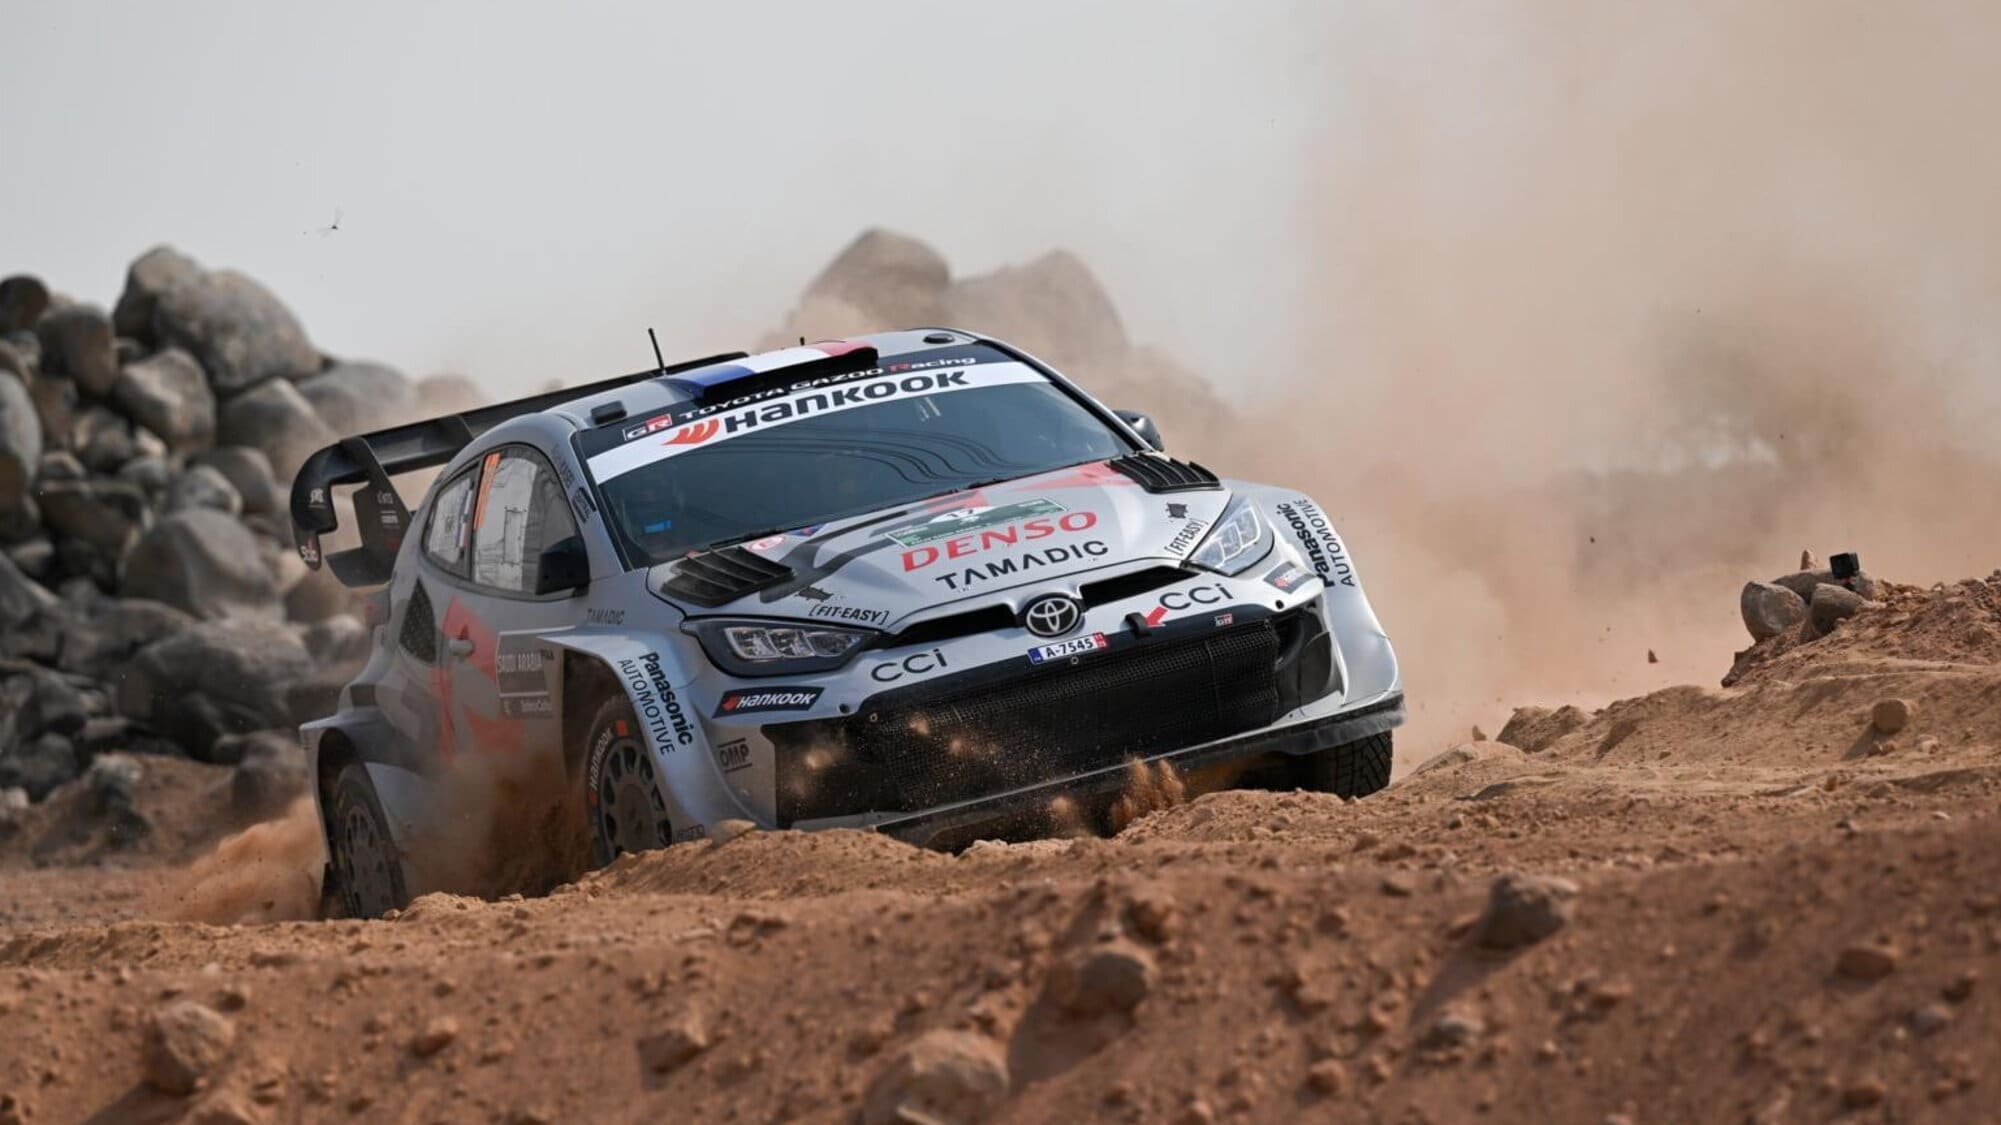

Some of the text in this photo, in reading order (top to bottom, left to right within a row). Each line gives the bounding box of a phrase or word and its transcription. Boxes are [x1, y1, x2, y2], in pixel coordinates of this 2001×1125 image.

[625, 356, 977, 439] GR TOYOTA GAZOO Racing
[902, 511, 1097, 572] DENSO
[935, 540, 1109, 591] TAMADIC
[1275, 502, 1335, 588] Panasonic
[1295, 498, 1355, 588] AUTOMOTIVE
[1045, 637, 1094, 658] A-7545
[617, 658, 676, 756] AUTOMOTIVE
[638, 650, 695, 747] Panasonic
[719, 742, 751, 768] OMP
